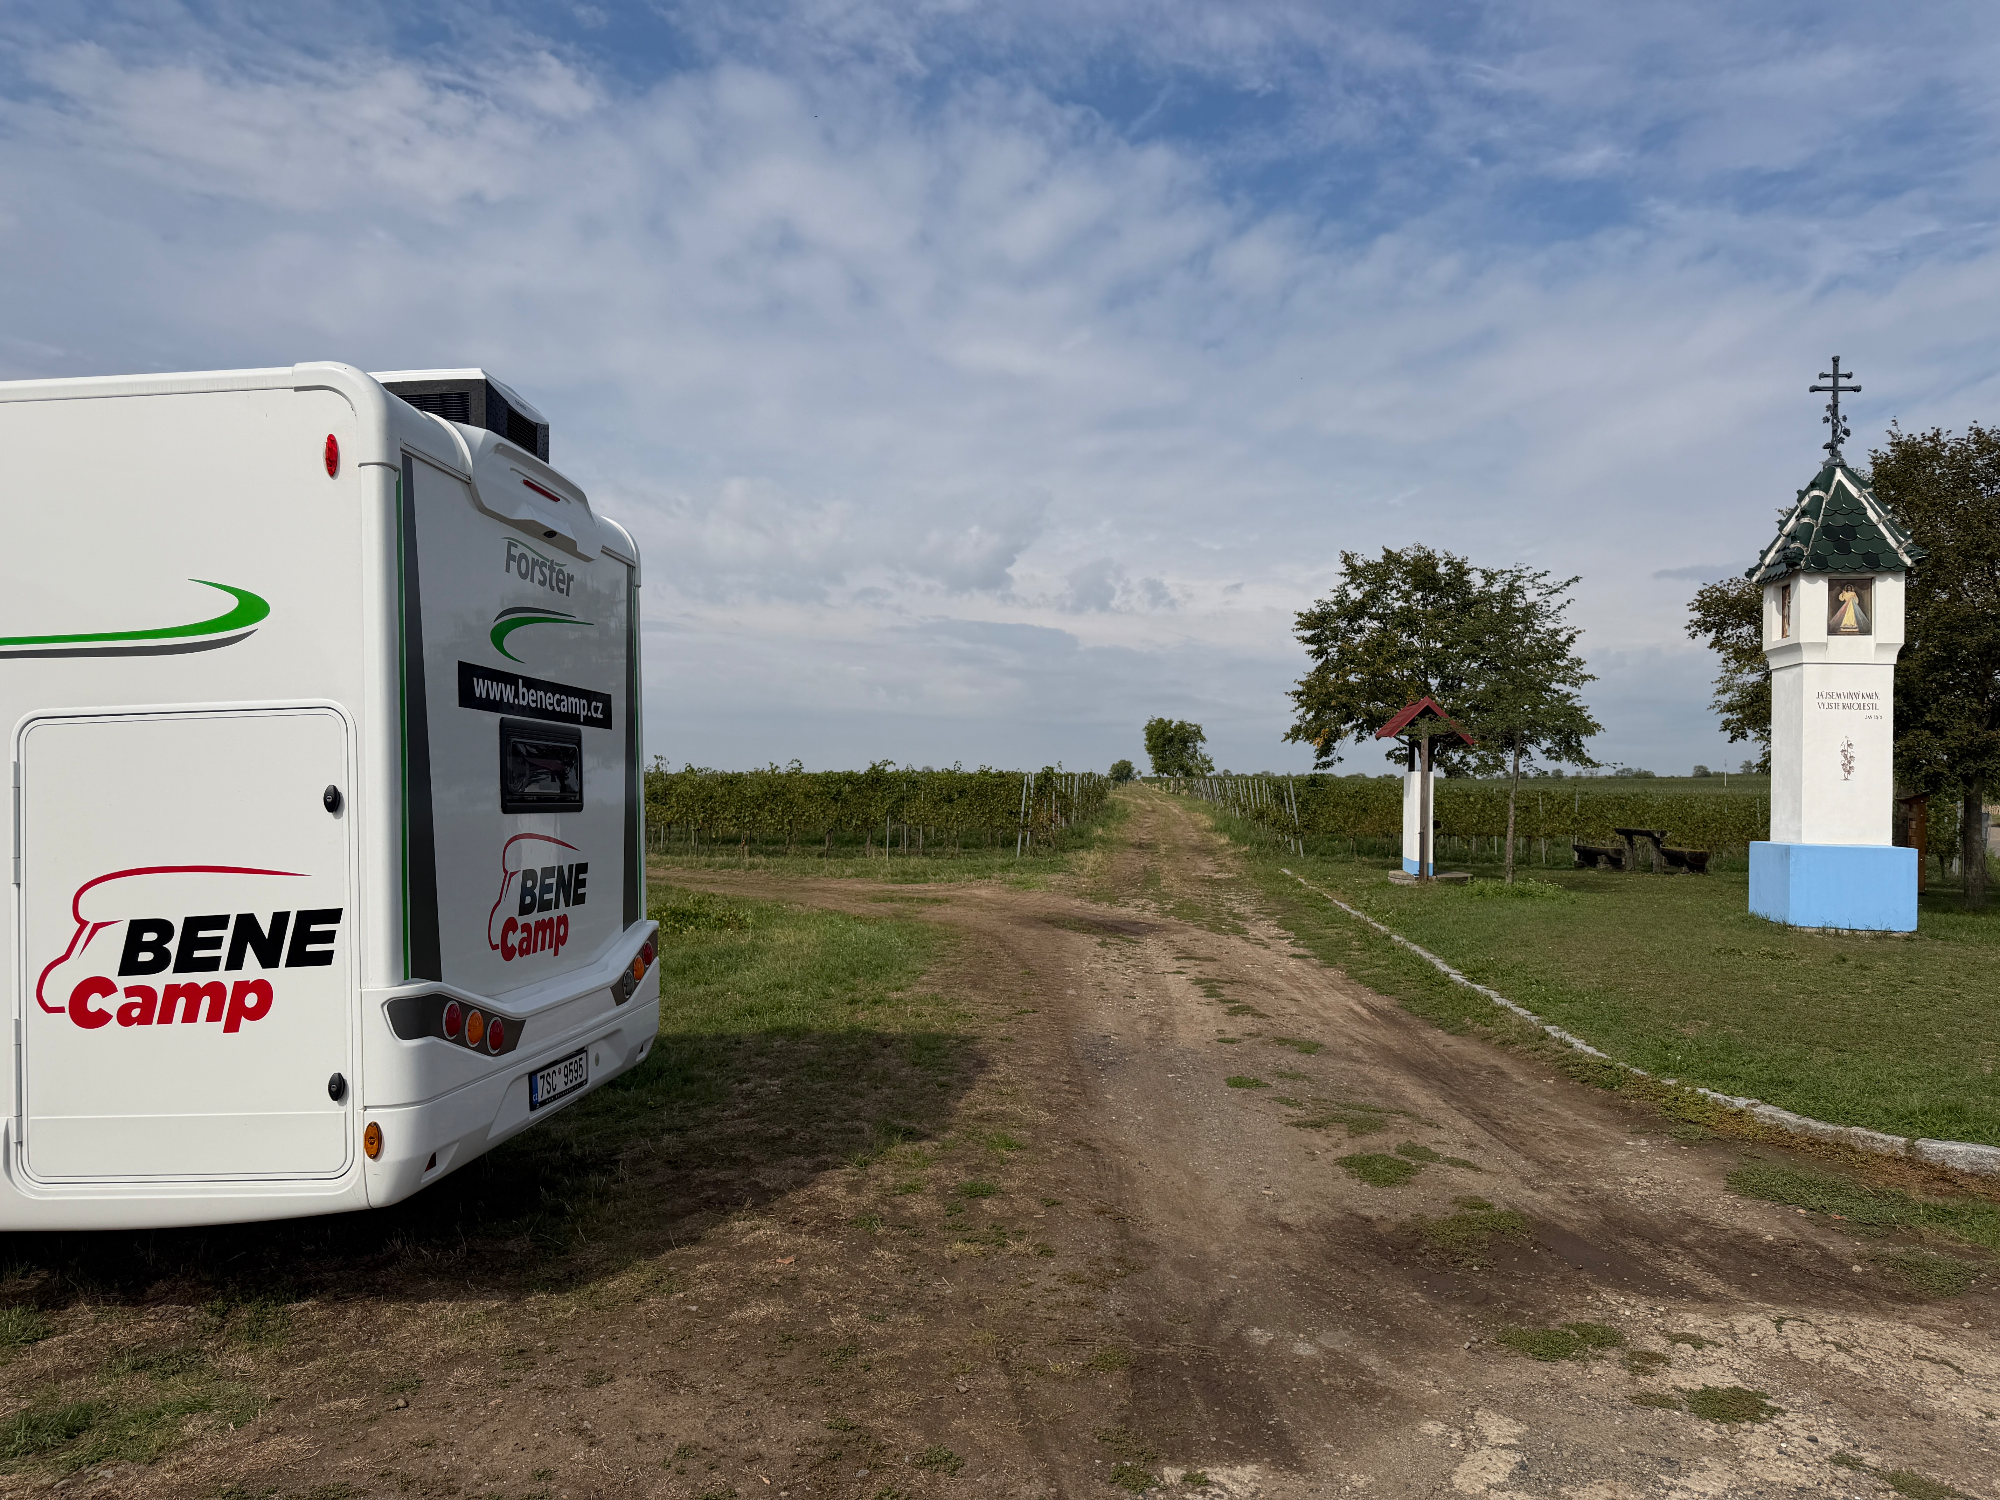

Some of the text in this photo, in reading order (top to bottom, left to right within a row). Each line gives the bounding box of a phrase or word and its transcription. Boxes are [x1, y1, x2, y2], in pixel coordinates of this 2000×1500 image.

[505, 541, 575, 598] Forster
[473, 677, 604, 722] www.benecamp.cz
[518, 862, 589, 917] BENE
[117, 907, 343, 977] BENE
[501, 913, 569, 962] Camp
[68, 975, 274, 1034] Camp
[540, 1070, 557, 1098] 7SC
[564, 1057, 583, 1086] 9595
